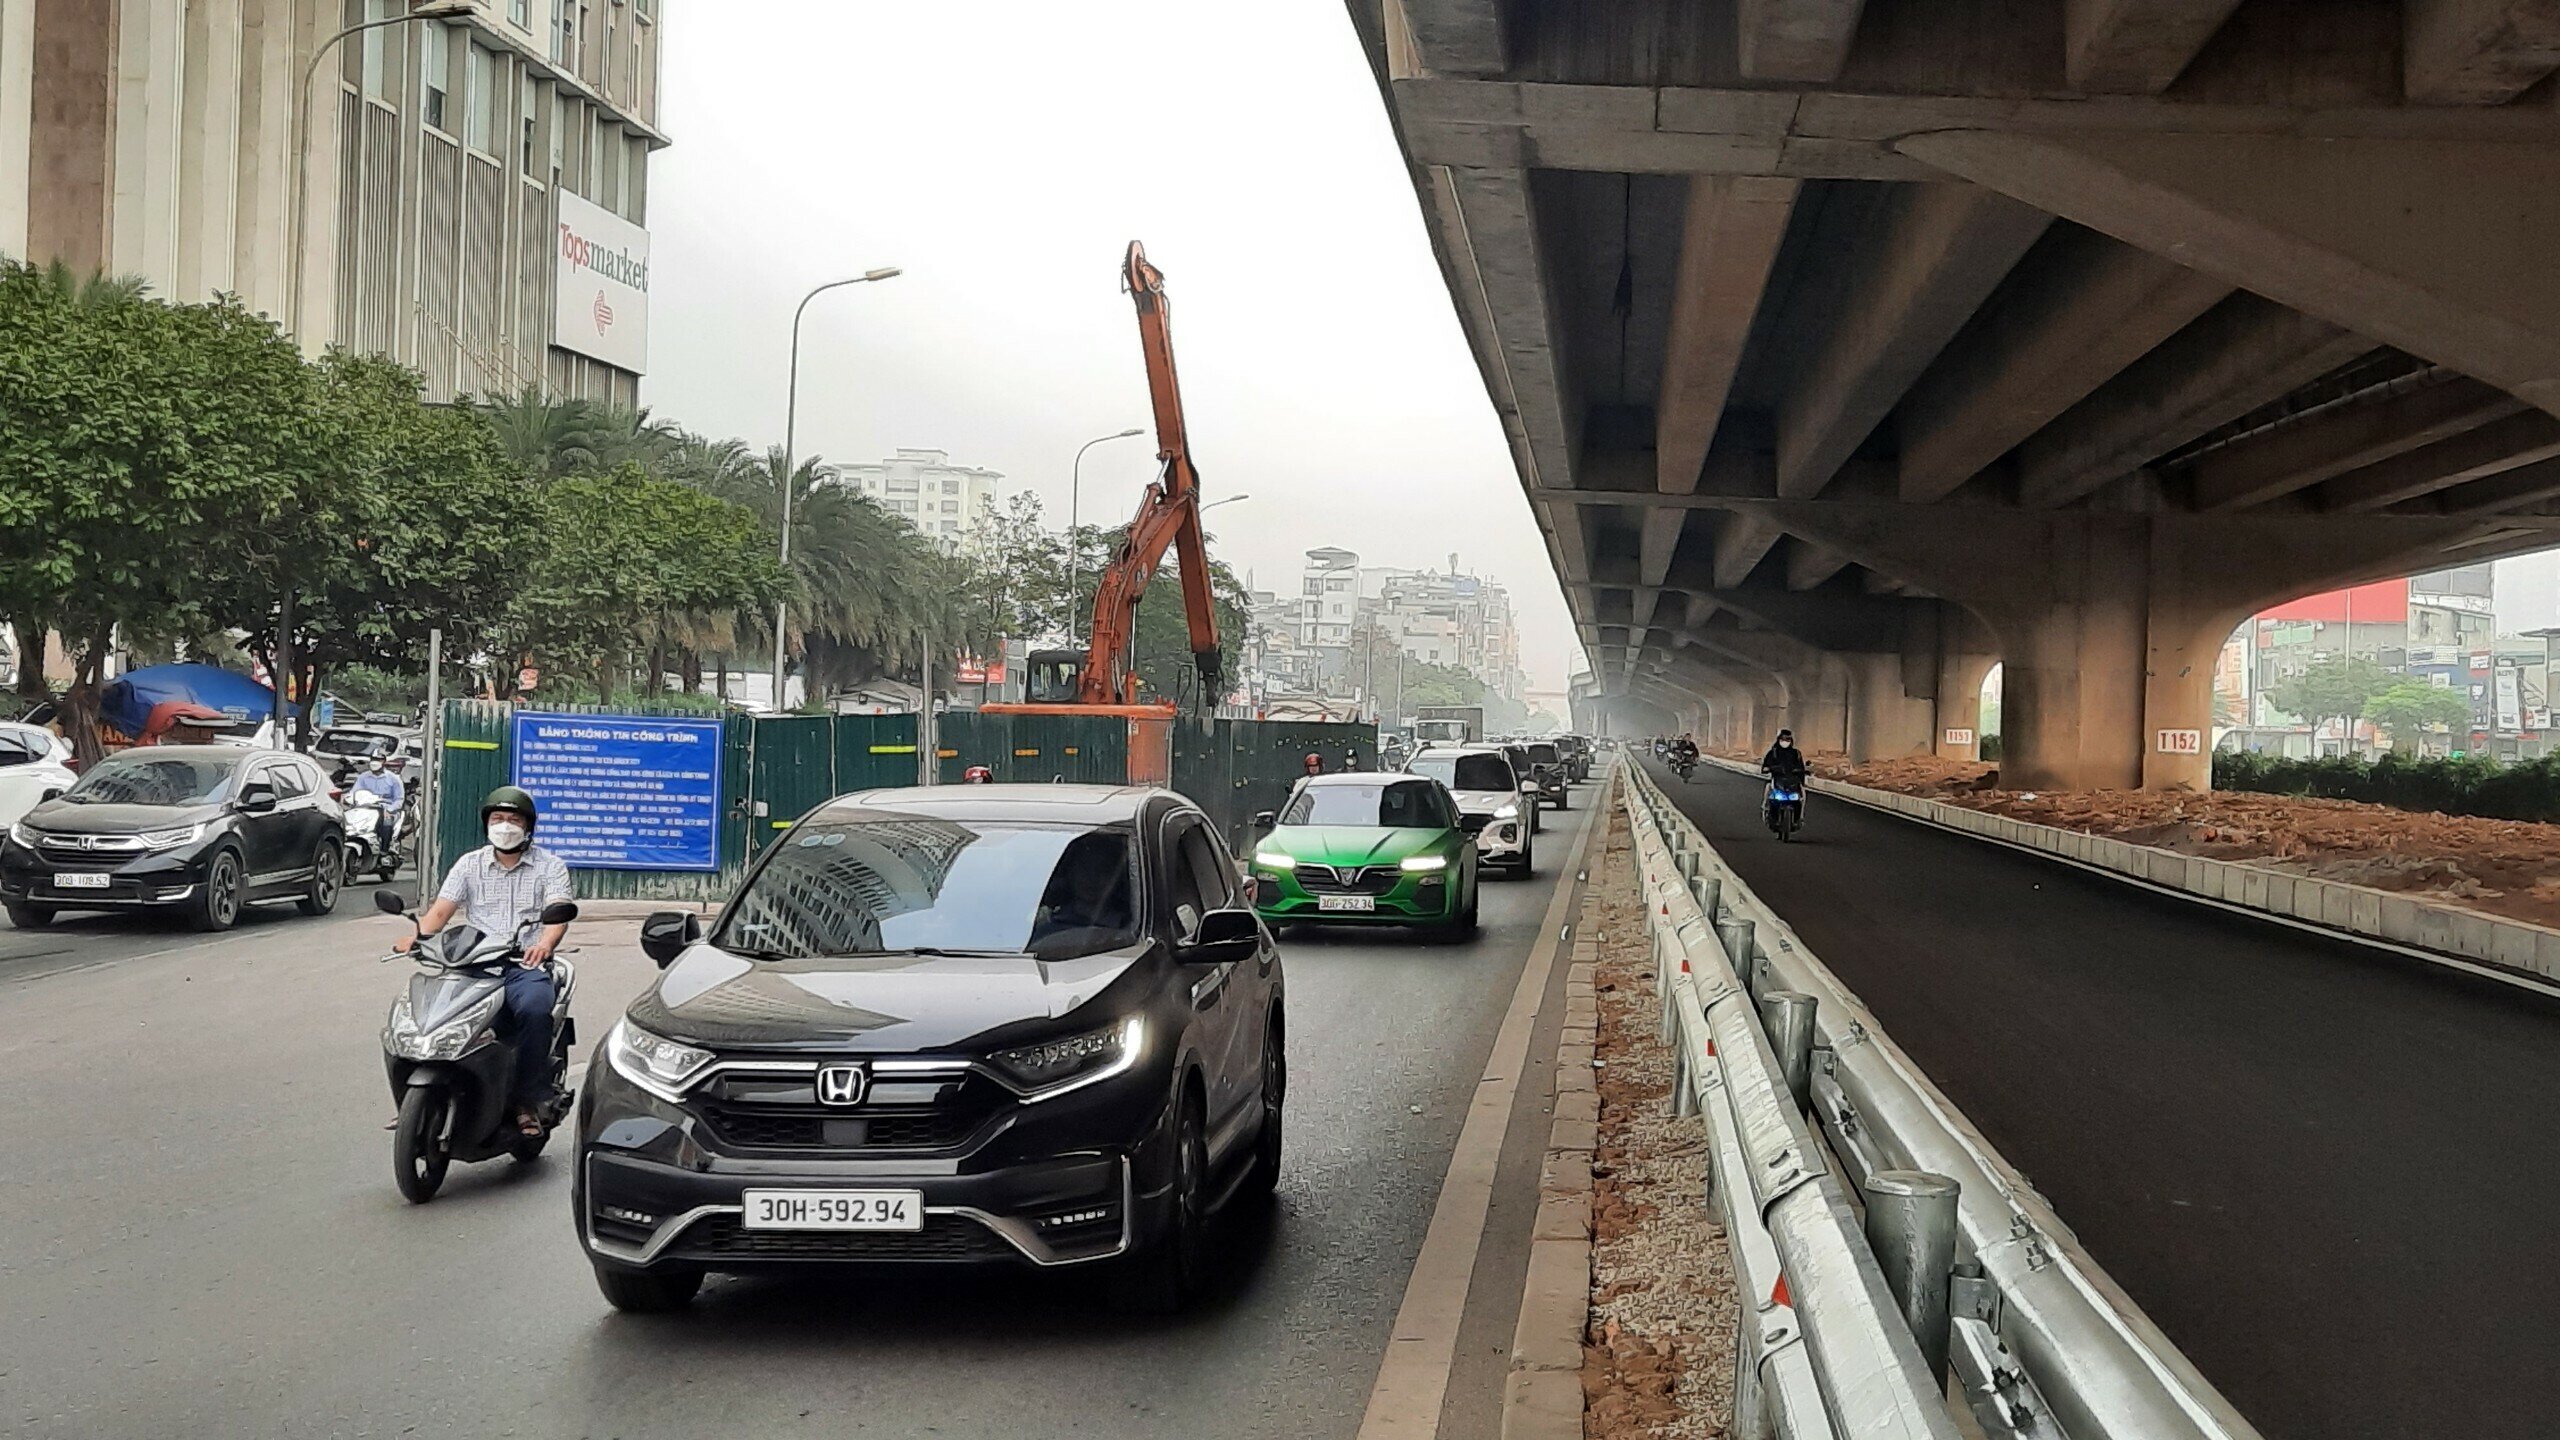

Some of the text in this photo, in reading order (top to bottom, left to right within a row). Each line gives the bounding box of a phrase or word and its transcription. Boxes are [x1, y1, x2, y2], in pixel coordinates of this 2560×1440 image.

[560, 222, 649, 293] Topsmarket
[571, 727, 611, 740] THÔNG
[759, 1198, 905, 1223] 30H-592.94
